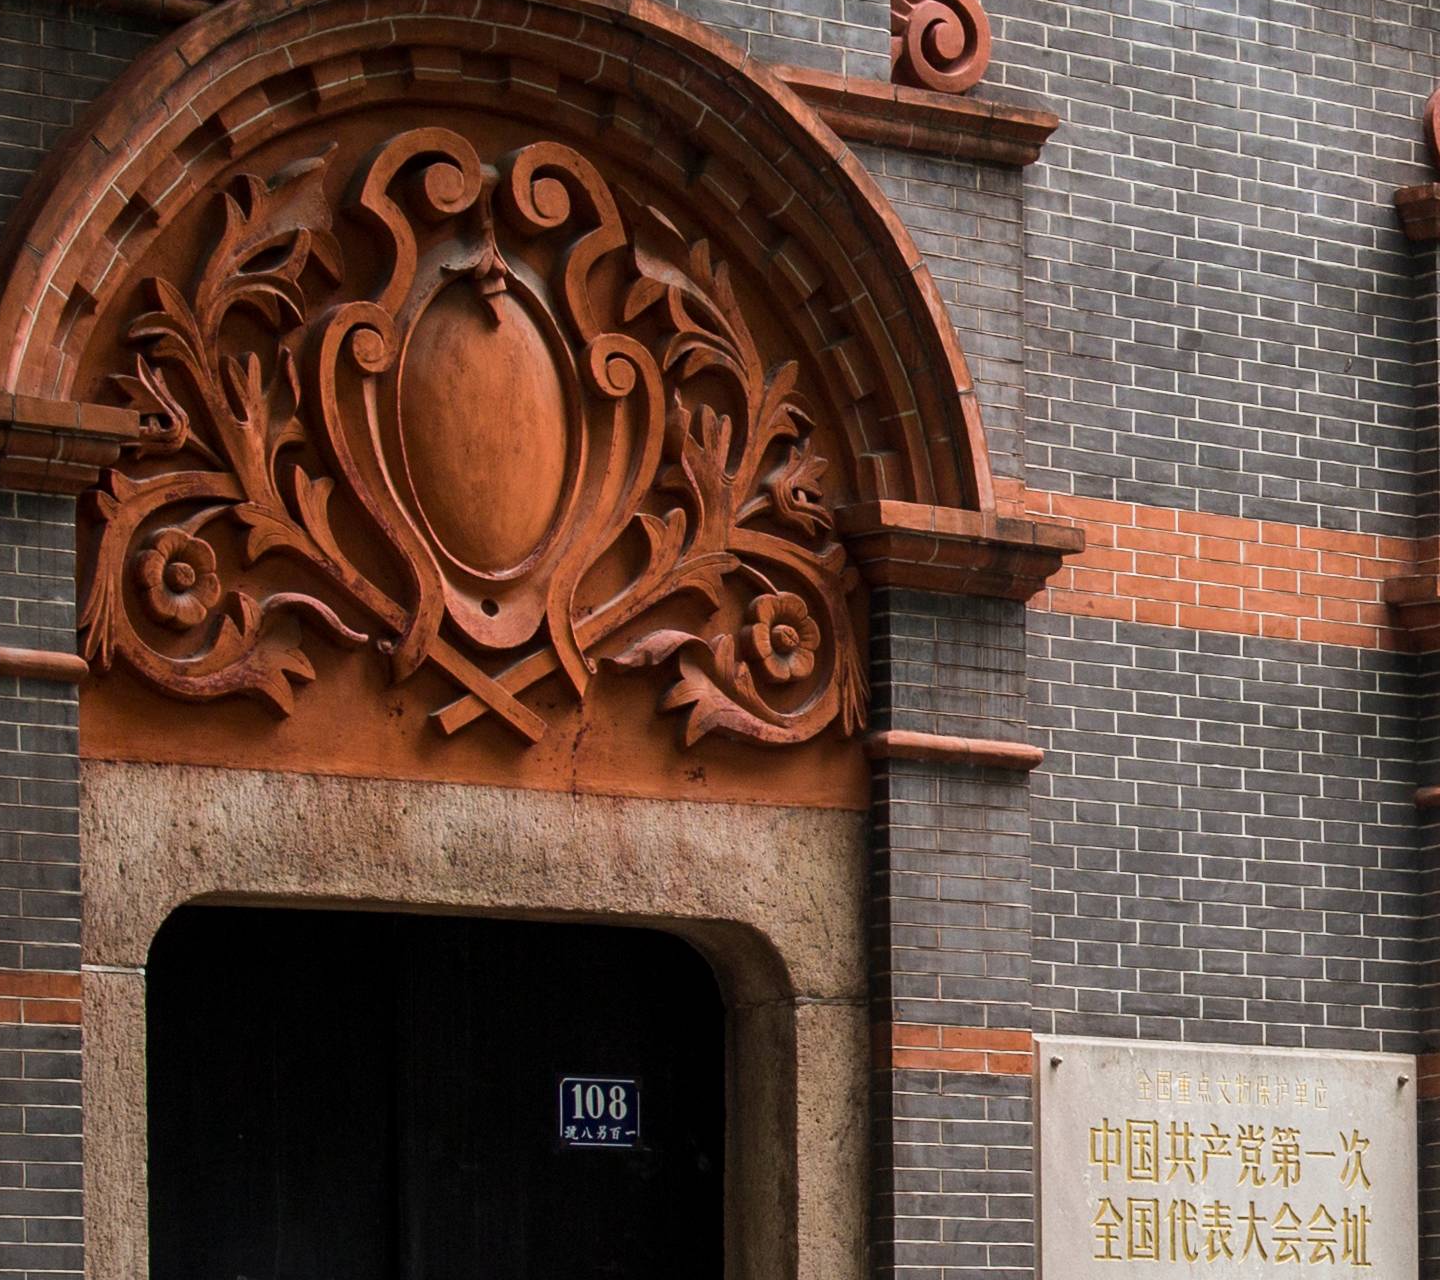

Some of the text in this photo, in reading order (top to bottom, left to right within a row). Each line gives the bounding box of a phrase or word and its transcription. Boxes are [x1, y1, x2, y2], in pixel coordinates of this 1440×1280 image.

[571, 1083, 627, 1120] 108
[1135, 1068, 1329, 1110] 全国重点文物保护单位
[1088, 1117, 1372, 1192] 中国共产党第一次
[1092, 1197, 1372, 1267] 全国代表大会会址
